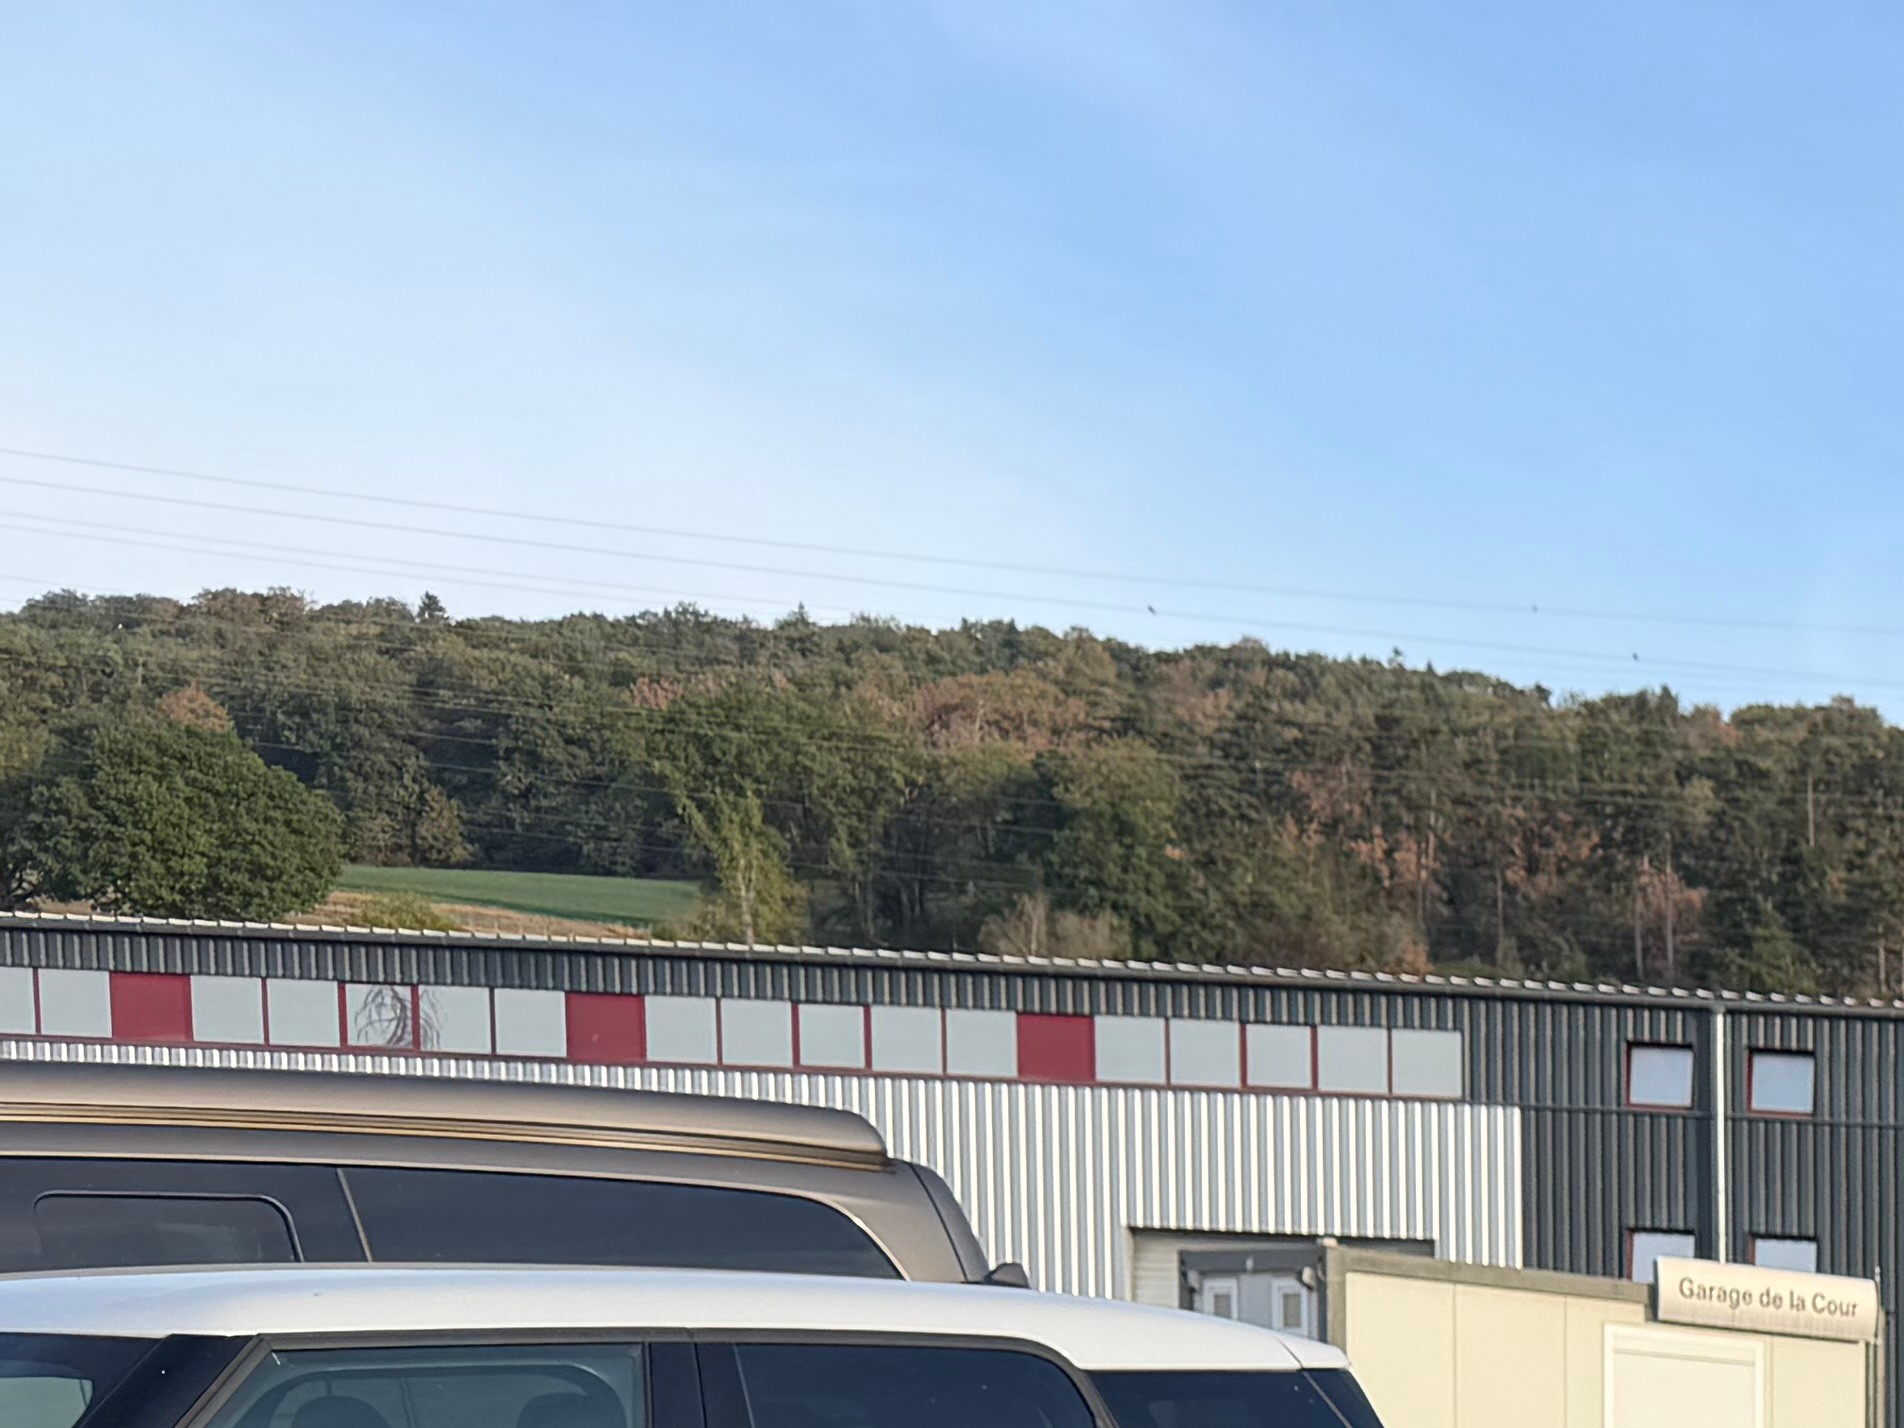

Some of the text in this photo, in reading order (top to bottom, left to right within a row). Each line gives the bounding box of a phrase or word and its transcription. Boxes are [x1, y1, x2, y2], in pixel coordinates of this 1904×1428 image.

[1678, 1276, 1859, 1317] Garage de la Cour
